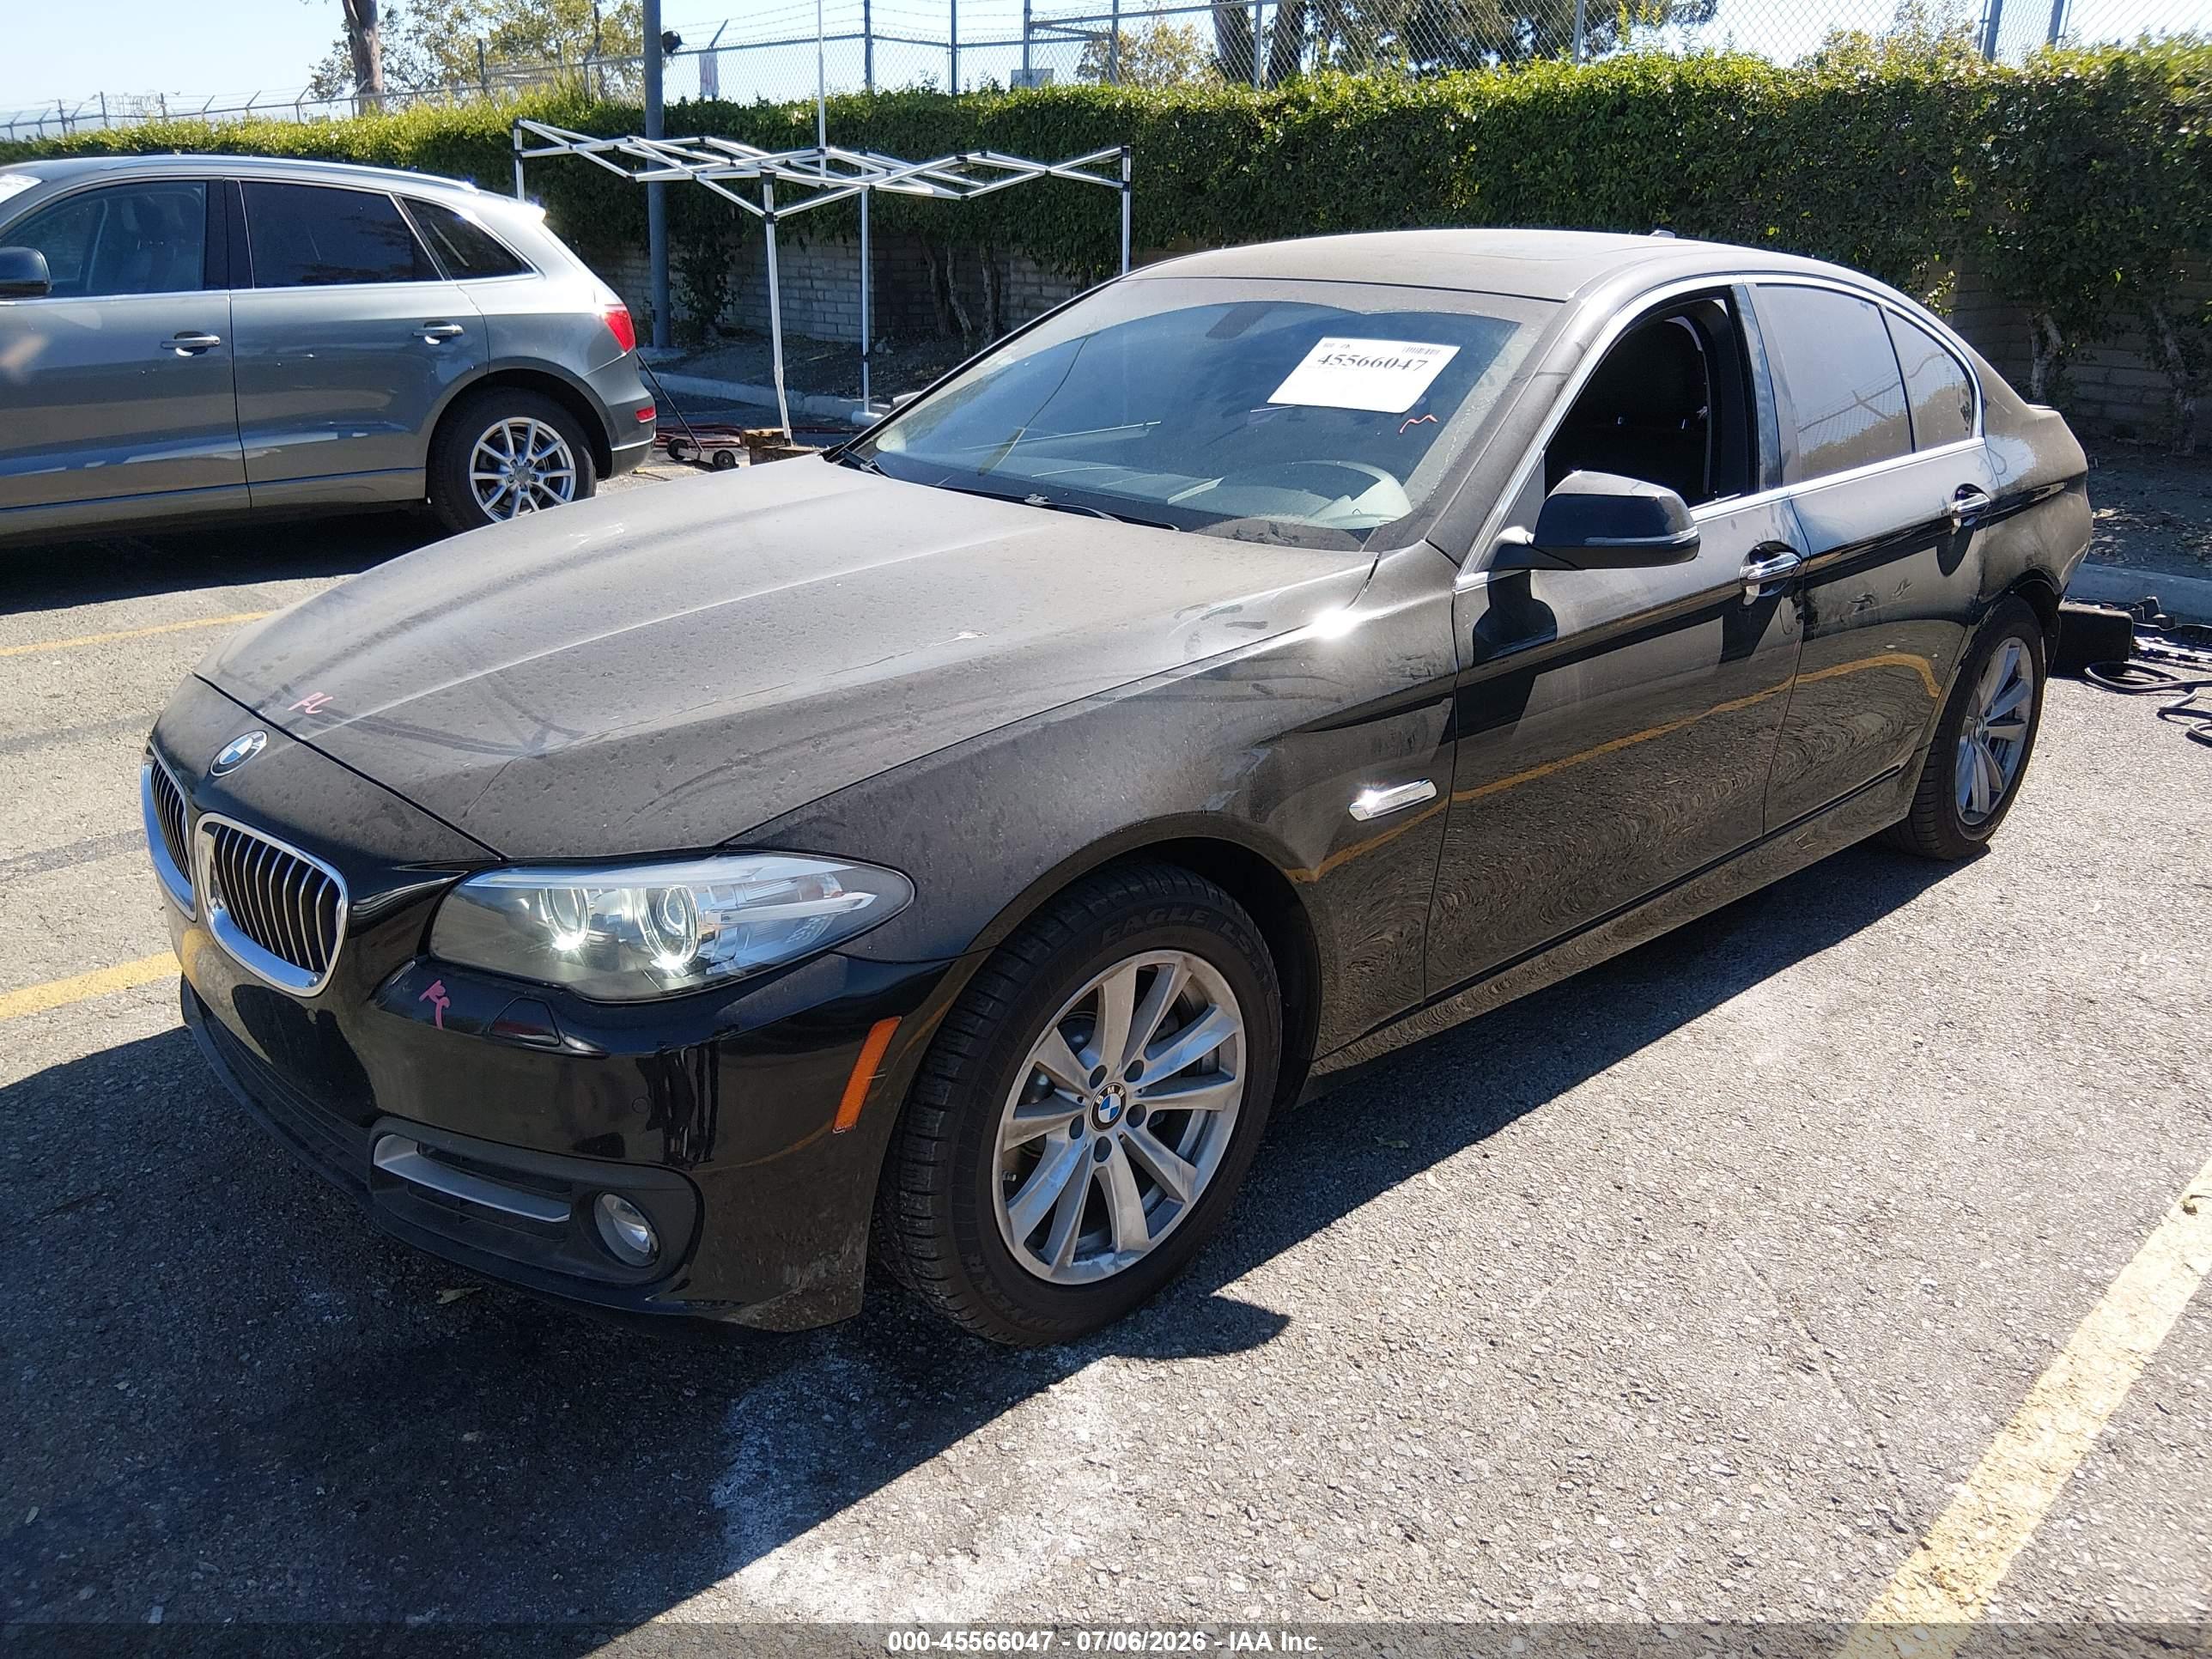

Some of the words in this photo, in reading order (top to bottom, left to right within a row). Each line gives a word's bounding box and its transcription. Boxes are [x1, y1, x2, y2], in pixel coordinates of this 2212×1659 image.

[1317, 354, 1428, 371] 45566047
[1103, 907, 1210, 942] EAGLE
[1096, 1085, 1125, 1104] BMW
